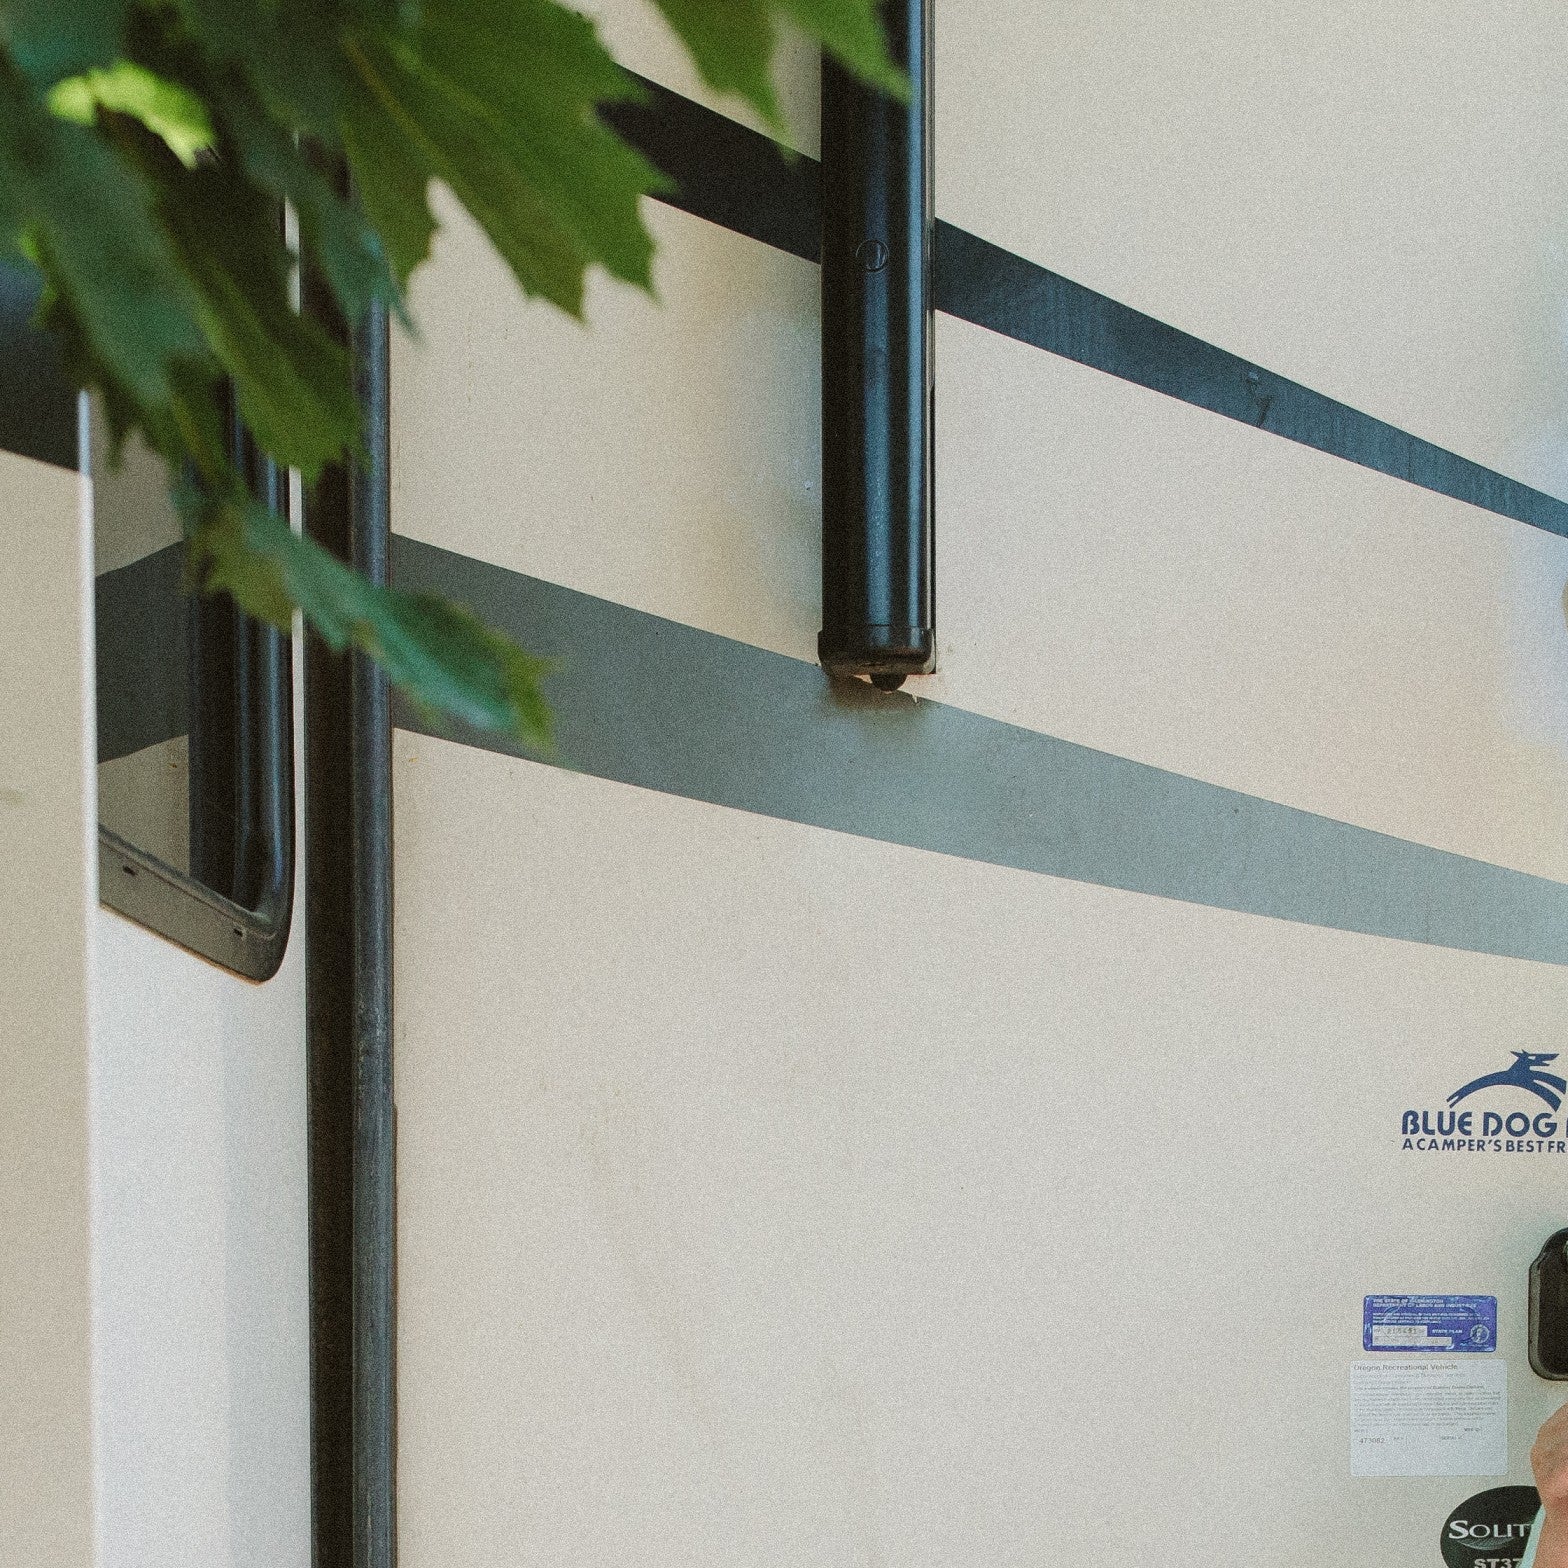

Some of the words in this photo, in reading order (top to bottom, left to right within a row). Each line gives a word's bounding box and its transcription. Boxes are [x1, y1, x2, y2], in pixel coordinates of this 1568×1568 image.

[1401, 1110, 1473, 1136] BLUE
[1482, 1111, 1558, 1138] DOG
[1402, 1138, 1414, 1151] A
[1416, 1138, 1502, 1152] CAMPER'S
[1505, 1140, 1544, 1153] BEST
[1353, 1364, 1381, 1372] Oregon
[1382, 1363, 1429, 1371] Recreational
